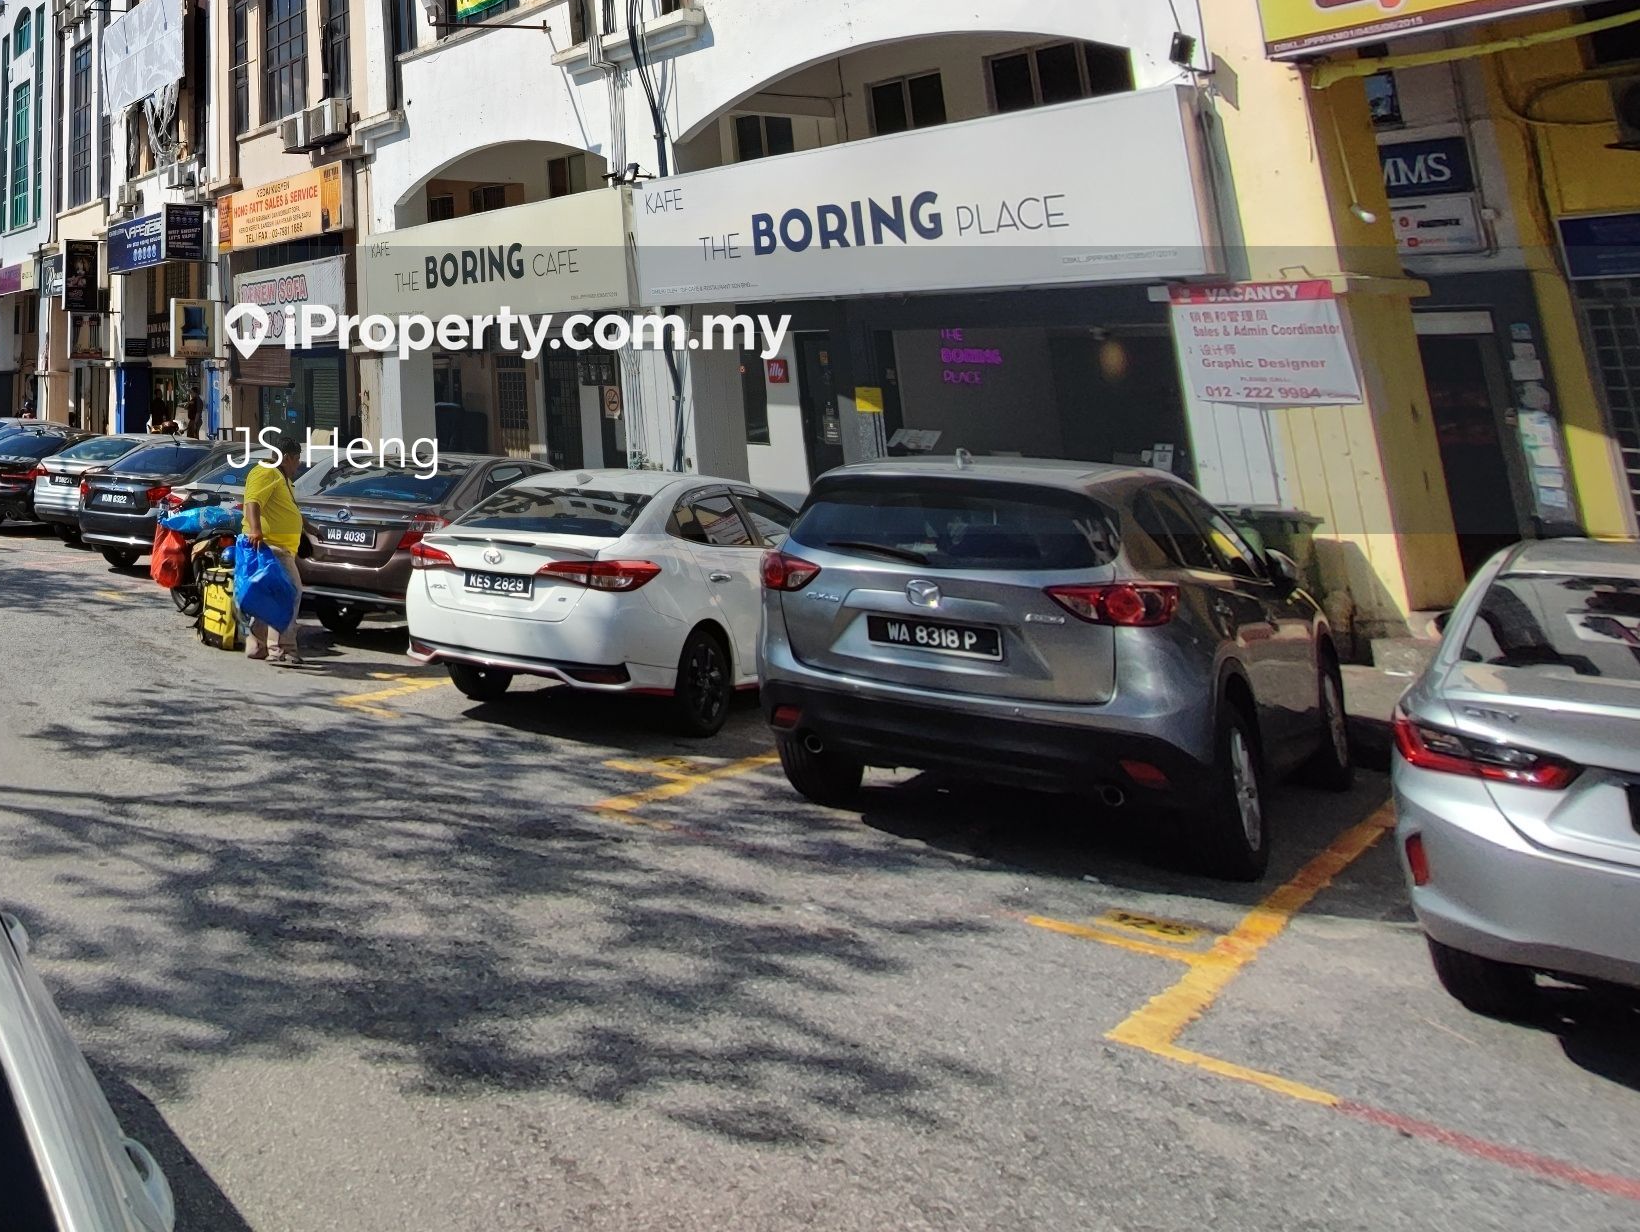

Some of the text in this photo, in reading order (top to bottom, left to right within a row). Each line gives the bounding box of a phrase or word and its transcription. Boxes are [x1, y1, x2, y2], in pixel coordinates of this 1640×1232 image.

[248, 200, 263, 216] FATT
[264, 196, 283, 211] SALES
[290, 184, 318, 204] SERVICE
[644, 188, 684, 215] KAFE
[699, 190, 1070, 262] THE BORING PLACE
[370, 241, 390, 258] KAFE
[394, 242, 579, 293] THE BORING CAFE
[278, 274, 308, 304] SOFA
[1205, 285, 1299, 303] VACANCY
[1193, 323, 1342, 337] Sales & Admin Coordinator
[1199, 343, 1238, 356] 设计师
[768, 361, 784, 380] illy
[1201, 358, 1327, 372] Graphic Designer
[943, 370, 982, 385] PLACE
[1205, 386, 1233, 399] 012
[1243, 386, 1274, 399] 222
[1277, 385, 1322, 399] 9984
[327, 527, 366, 543] VAB 4039
[469, 574, 524, 591] KES 2829
[806, 590, 840, 604] CX-5
[886, 622, 978, 650] WA 8318 P
